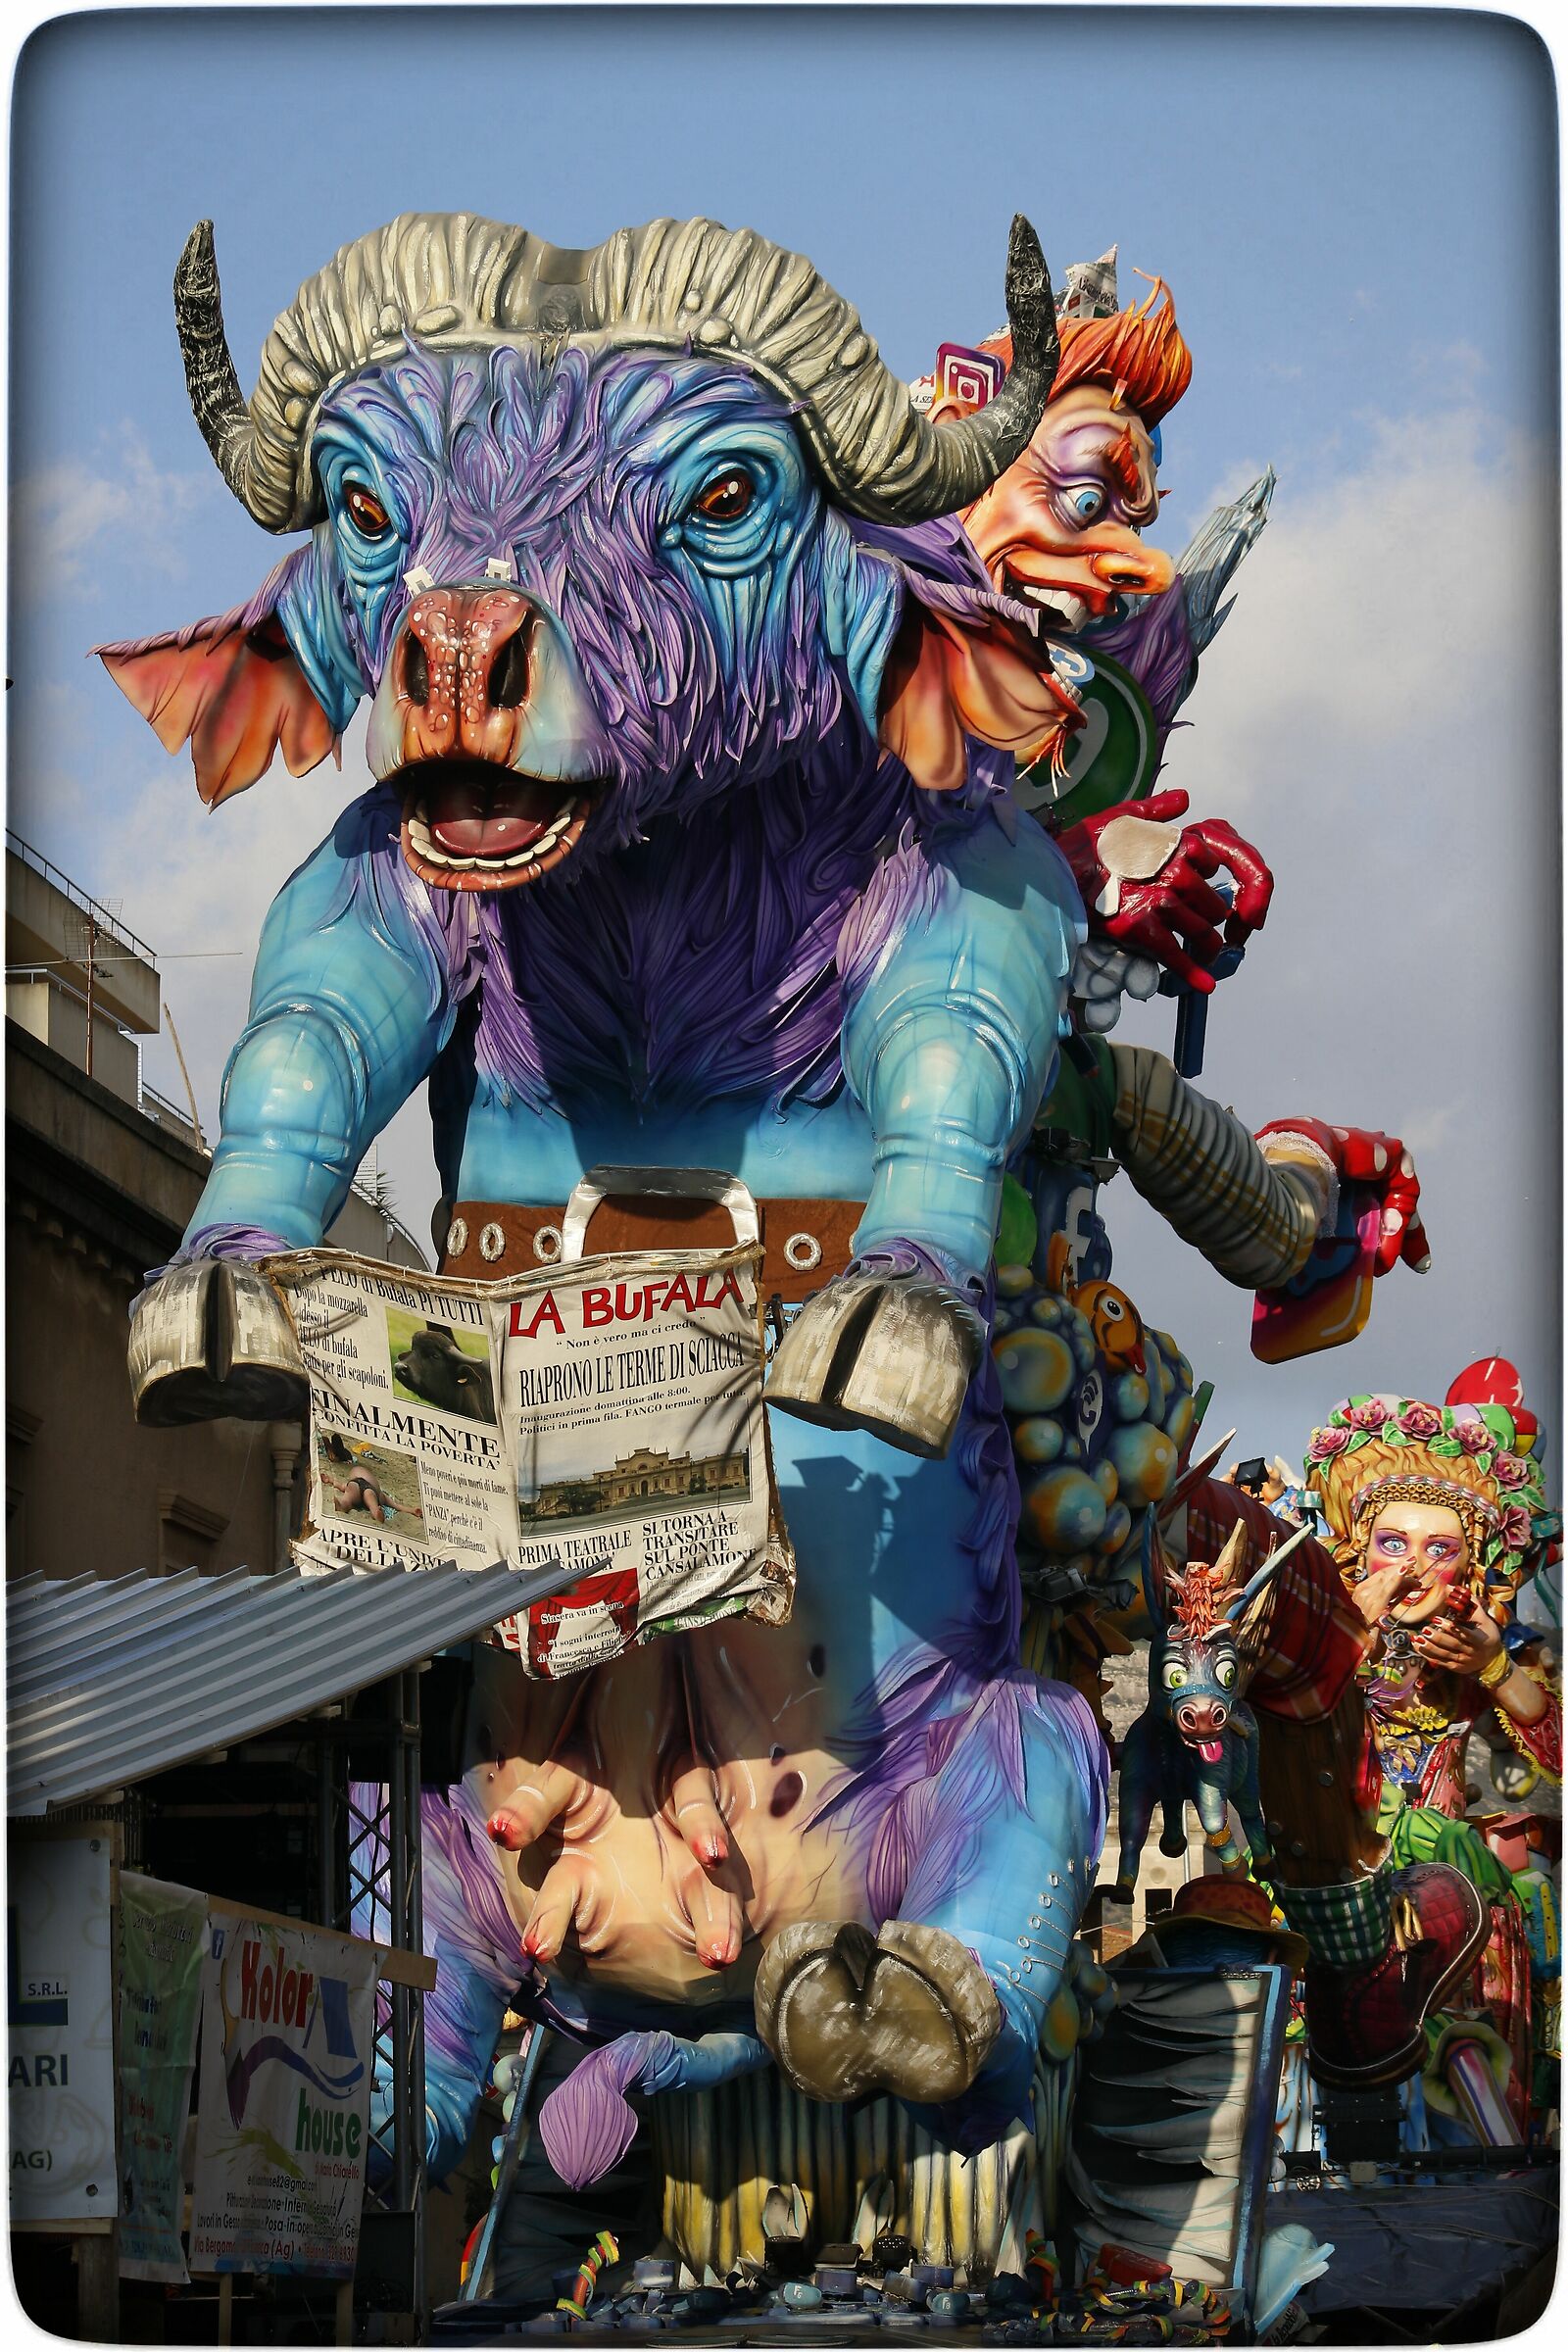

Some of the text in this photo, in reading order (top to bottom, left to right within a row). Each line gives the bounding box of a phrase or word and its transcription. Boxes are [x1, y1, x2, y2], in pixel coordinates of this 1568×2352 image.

[293, 1282, 368, 1318] Dopo la mozzarella
[362, 1274, 373, 1294] di
[376, 1278, 417, 1309] Bufala
[417, 1290, 435, 1315] PI
[435, 1296, 484, 1325] TUTTI
[509, 1270, 745, 1339] LA BUFALA
[323, 1309, 330, 1329] il
[566, 1339, 591, 1350] Non
[593, 1336, 600, 1348] è
[603, 1332, 628, 1345] vero
[631, 1328, 649, 1339] ma
[652, 1323, 662, 1335] ci
[664, 1319, 697, 1335] credo
[321, 1332, 330, 1352] di
[331, 1333, 359, 1359] bufala
[321, 1359, 335, 1379] per
[336, 1358, 347, 1384] gli
[348, 1365, 389, 1390] scapoloni.
[519, 1331, 746, 1408] RIAPRONO LE TERME DI SCIACCA
[519, 1386, 692, 1425] Inaugurazione domattina alle 8:00.
[519, 1390, 748, 1438] Politici in prima fila. FANGO termale per tutti.
[311, 1387, 501, 1459] FINALMENTE
[312, 1407, 501, 1471] CONFITTA LA POVERTA'
[420, 1460, 436, 1477] Meno
[436, 1469, 454, 1482] poveri
[484, 1480, 491, 1492] di
[491, 1480, 509, 1495] fame.
[422, 1482, 430, 1495] Ti
[443, 1491, 465, 1505] mettere
[464, 1494, 471, 1506] al
[471, 1495, 483, 1509] sole
[482, 1497, 489, 1512] la
[318, 1528, 371, 1549] APRE
[478, 1518, 483, 1531] il
[642, 1509, 727, 1537] SI TORNA A
[642, 1521, 740, 1551] TRANSITARE
[517, 1530, 632, 1564] PRIMA TEATRALE
[644, 1538, 731, 1567] SUL PONTE
[645, 1547, 758, 1581] CANSALAMONE
[541, 1601, 624, 1624] Stasera va in scena
[538, 1653, 549, 1663] di
[549, 1644, 593, 1662] Francesca
[560, 1635, 584, 1648] sogni
[27, 1983, 68, 1996] S.R.L.
[241, 1939, 315, 2029] Kolor
[8, 2053, 69, 2088] ARI
[295, 2086, 362, 2159] house
[197, 2212, 215, 2228] Lavori
[270, 2238, 295, 2261] (Ag)
